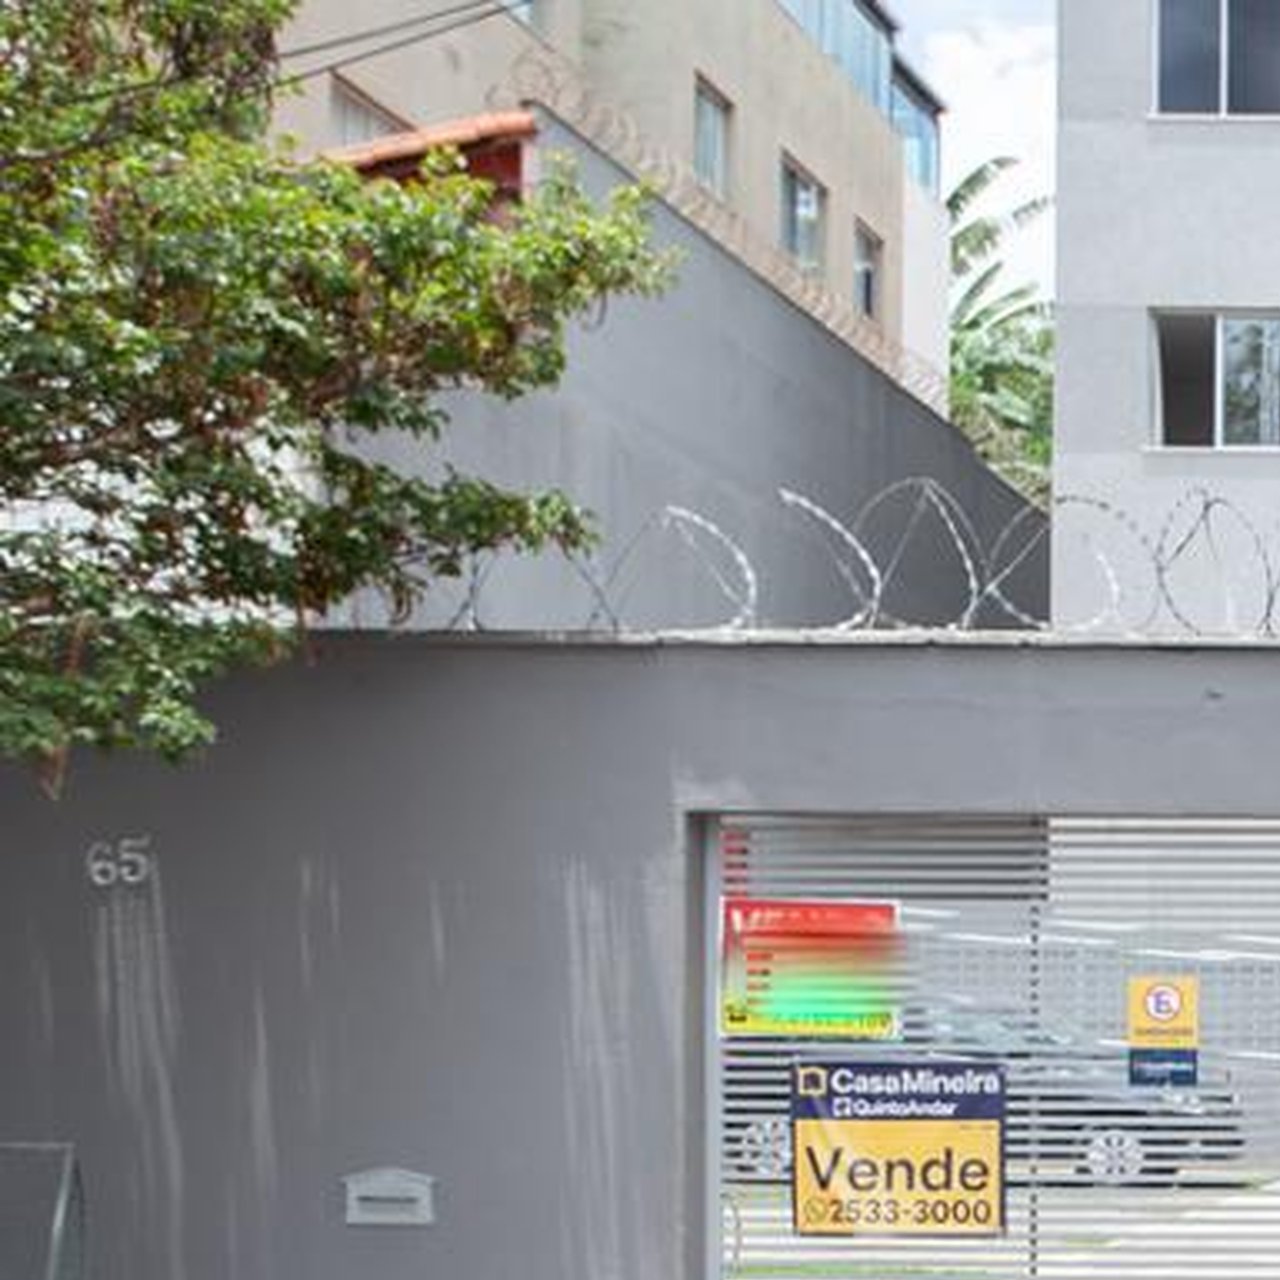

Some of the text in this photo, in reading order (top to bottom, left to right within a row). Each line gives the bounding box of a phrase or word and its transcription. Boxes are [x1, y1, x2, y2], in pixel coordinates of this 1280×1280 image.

[86, 834, 150, 885] 65
[805, 1146, 990, 1191] Vende
[828, 1199, 992, 1224] 2533-3000
